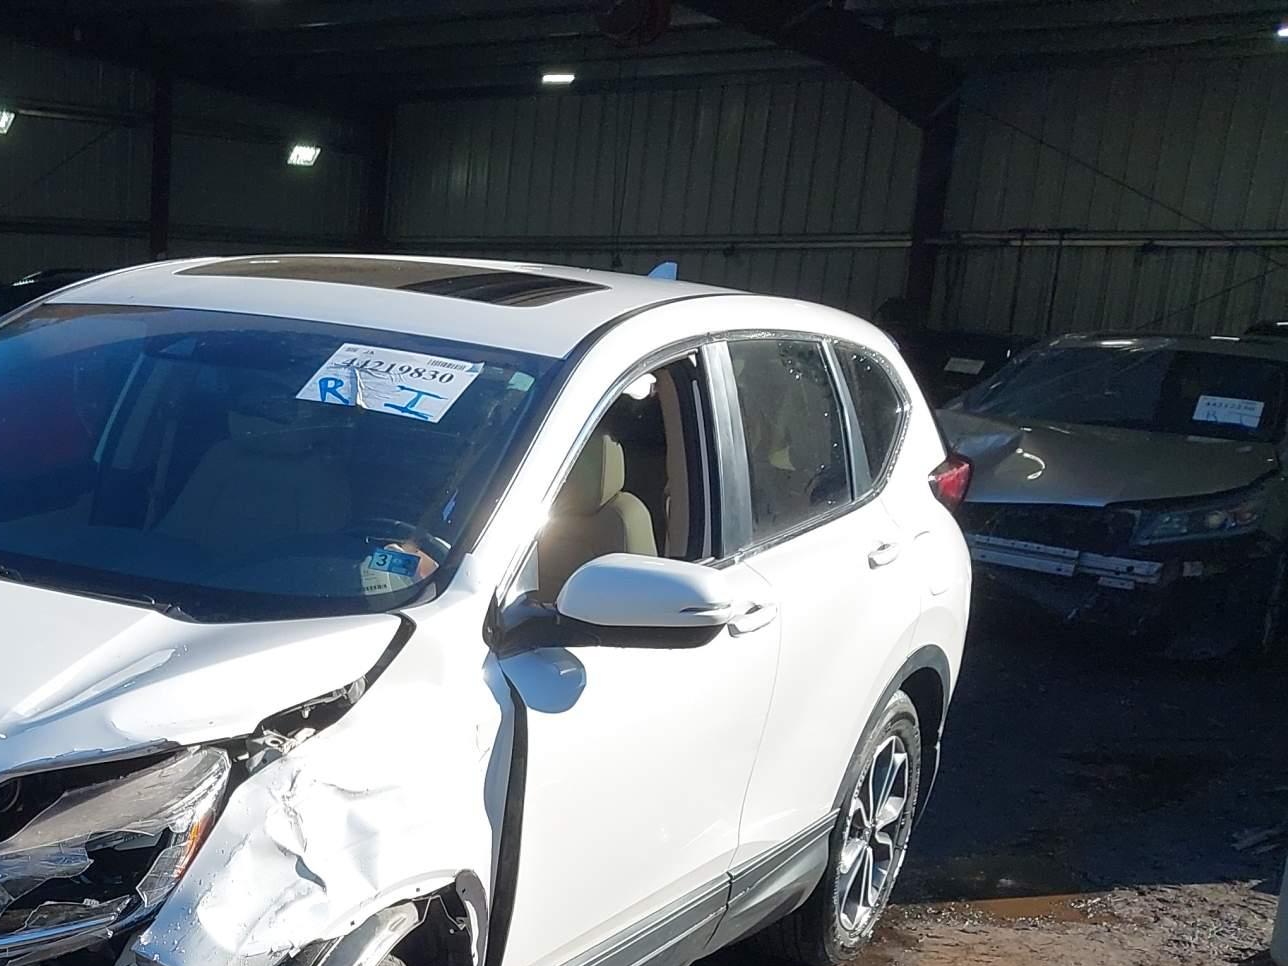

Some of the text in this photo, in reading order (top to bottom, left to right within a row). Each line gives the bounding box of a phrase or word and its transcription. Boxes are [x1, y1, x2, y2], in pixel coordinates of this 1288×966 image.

[341, 356, 454, 384] 44219830
[317, 376, 350, 405] R
[376, 554, 388, 567] 3
